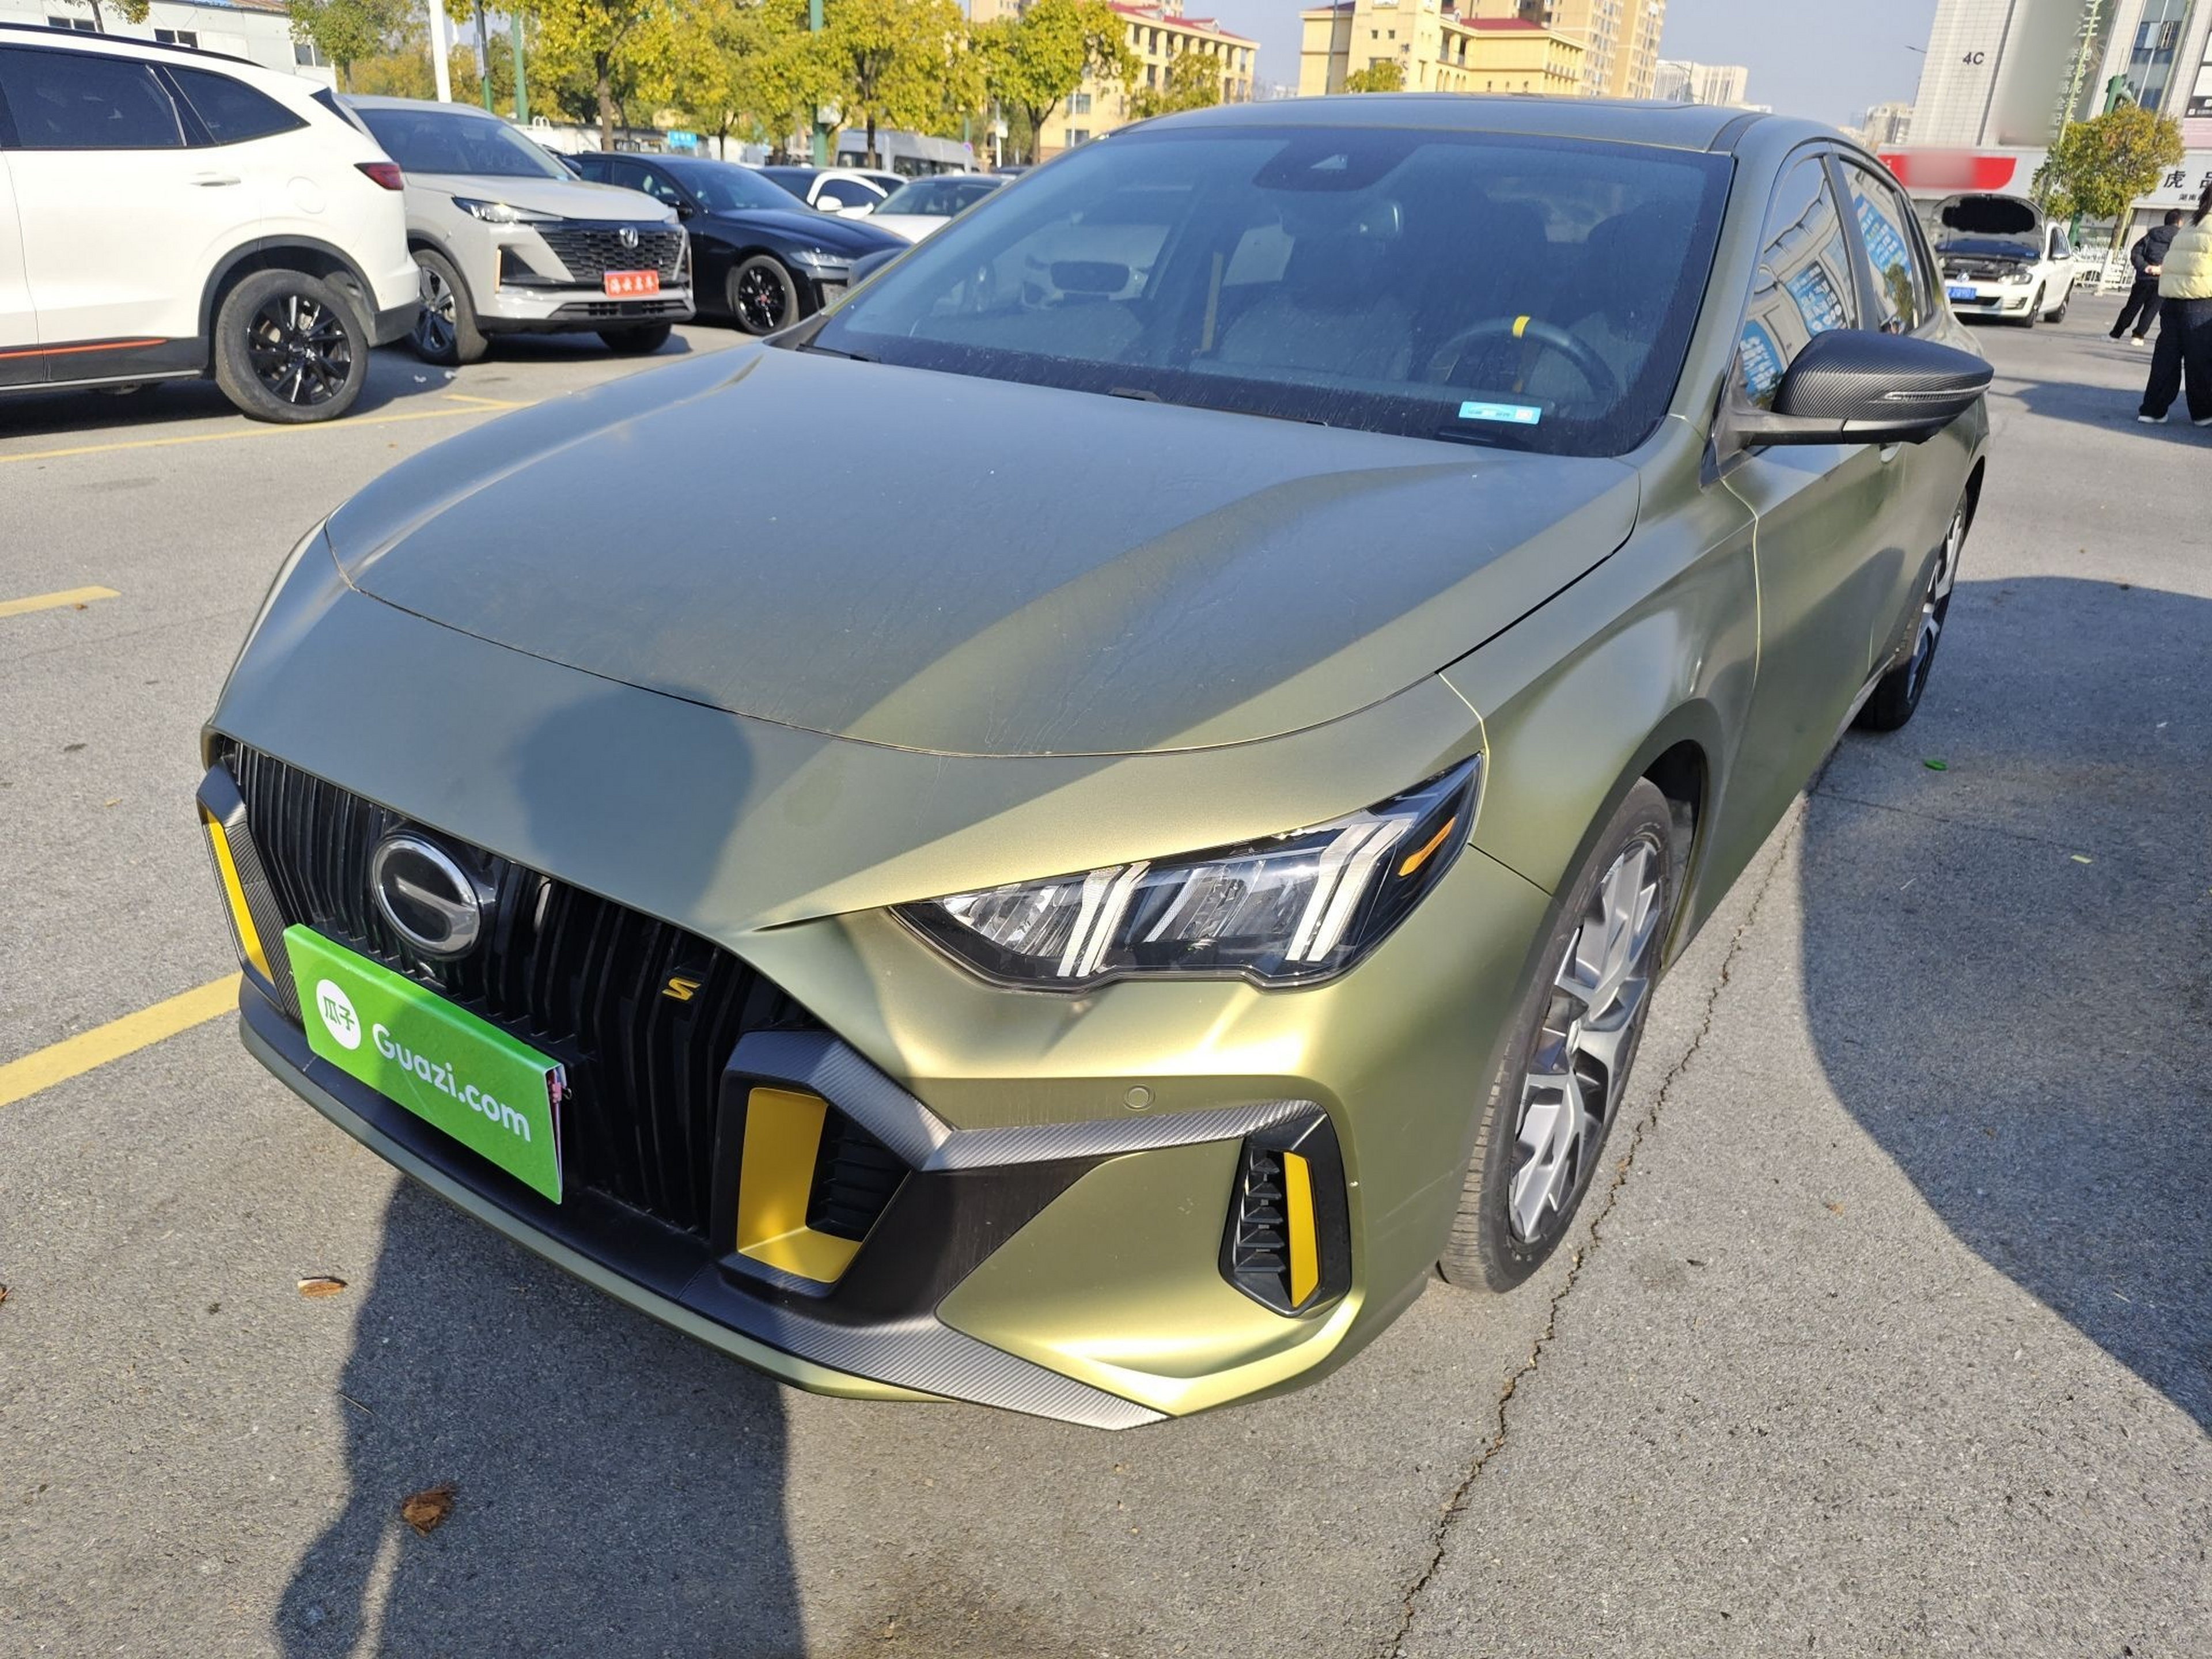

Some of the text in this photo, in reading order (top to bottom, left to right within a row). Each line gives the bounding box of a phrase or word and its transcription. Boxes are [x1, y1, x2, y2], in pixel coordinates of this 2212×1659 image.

[1963, 51, 1984, 65] 4C
[662, 976, 702, 1001] S
[323, 995, 355, 1032] 瓜子
[372, 1022, 531, 1142] Guazi.com
